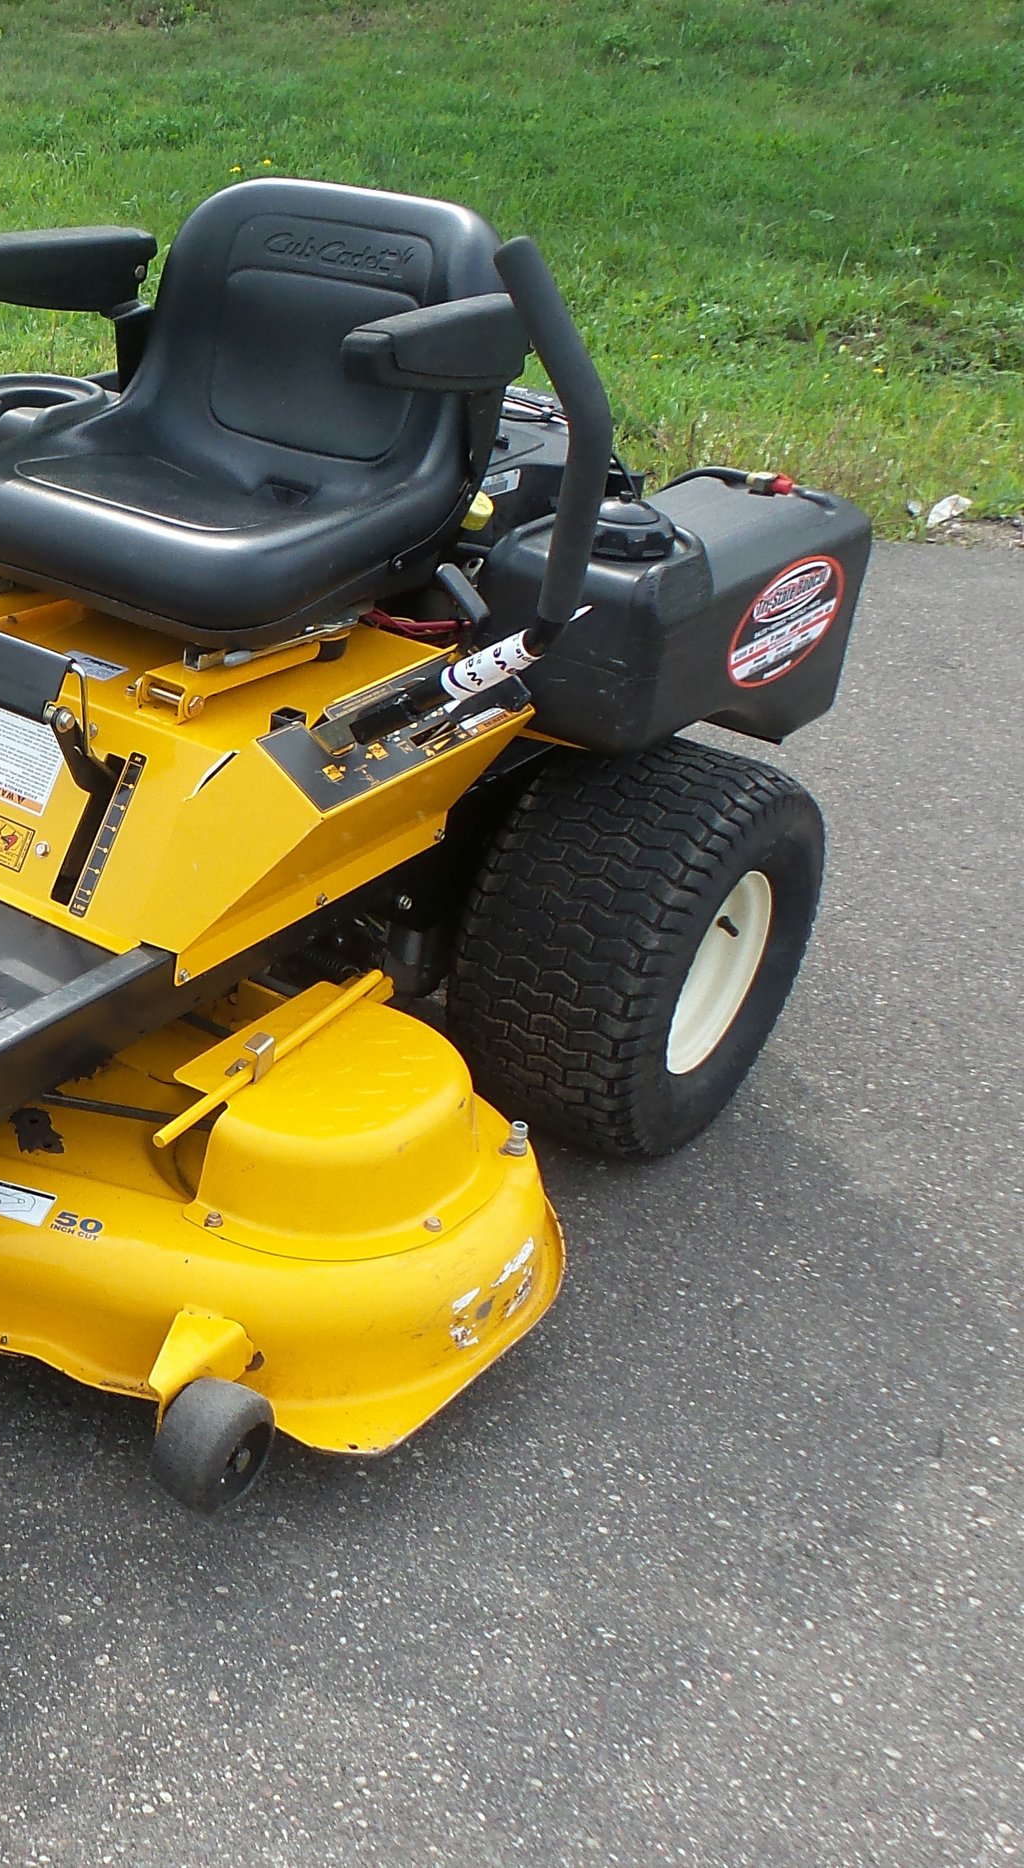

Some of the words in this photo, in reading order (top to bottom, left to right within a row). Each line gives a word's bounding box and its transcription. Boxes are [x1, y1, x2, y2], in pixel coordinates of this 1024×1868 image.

[262, 232, 314, 258] Cub
[318, 240, 396, 271] Cadet
[50, 1223, 76, 1235] INCH
[77, 1231, 99, 1241] CUT
[54, 1211, 103, 1234] 50
